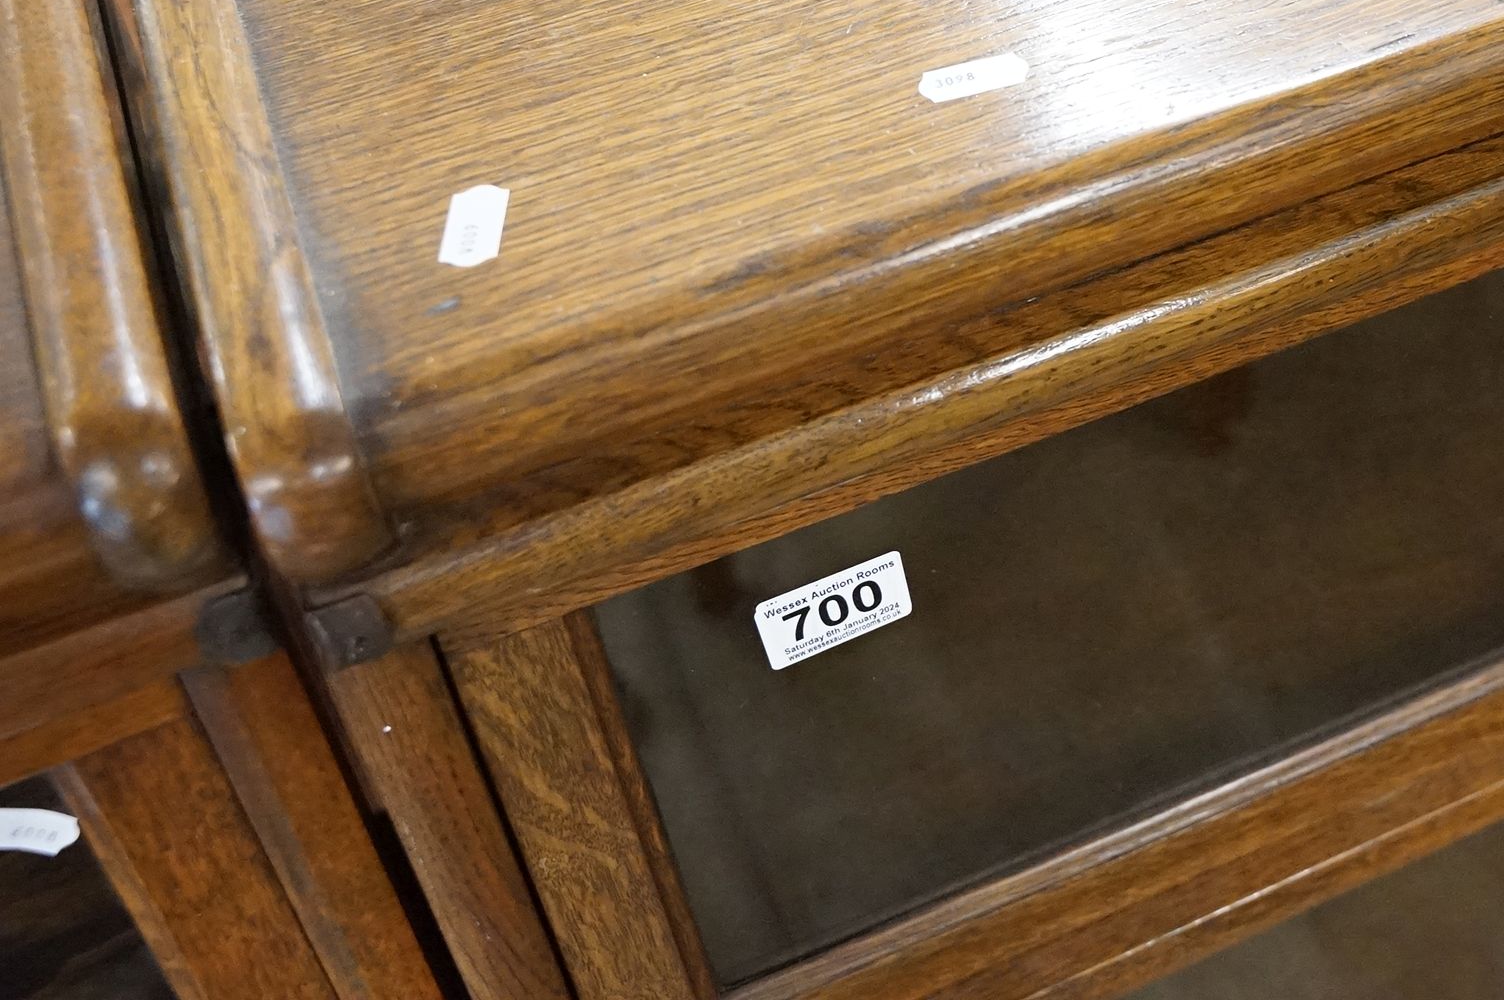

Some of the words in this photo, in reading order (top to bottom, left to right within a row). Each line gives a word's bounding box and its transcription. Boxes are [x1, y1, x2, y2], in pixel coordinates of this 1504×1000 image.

[764, 597, 808, 619] Wessex
[811, 577, 854, 600] Auction
[856, 560, 895, 580] Rooms
[782, 580, 883, 642] 700
[784, 633, 825, 655] Saturday
[825, 625, 841, 639] 6th
[842, 612, 878, 632] January
[880, 603, 900, 616] 2024
